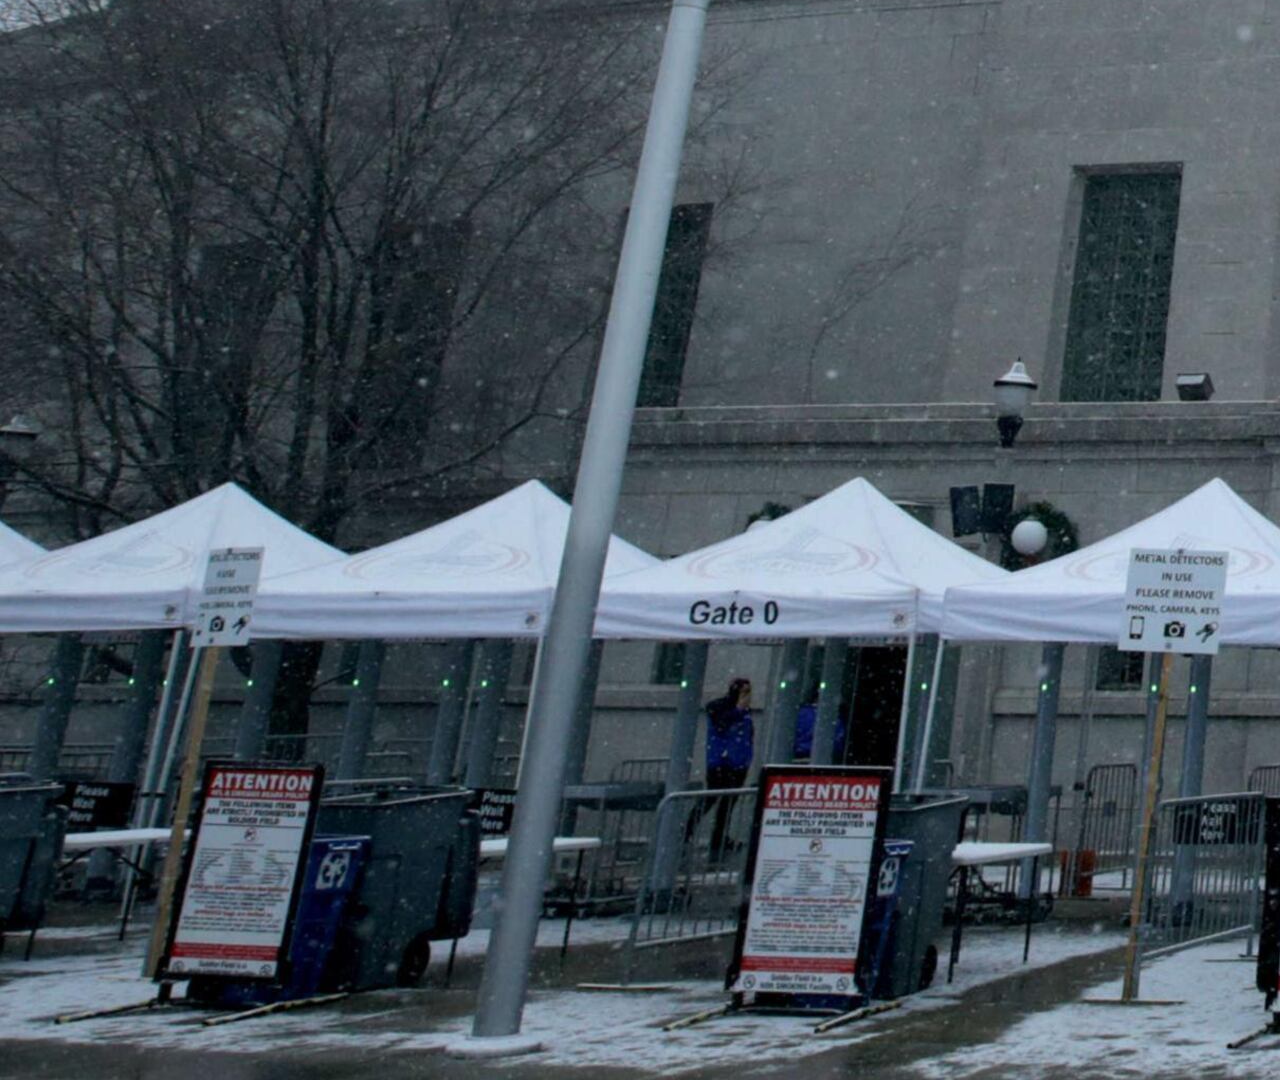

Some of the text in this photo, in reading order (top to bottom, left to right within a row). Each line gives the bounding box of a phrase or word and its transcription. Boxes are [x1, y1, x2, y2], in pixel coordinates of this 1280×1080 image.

[1135, 554, 1224, 566] METAL DETECTORS
[1162, 573, 1193, 582] IN USE
[1136, 588, 1214, 600] PLEASE REMOVE
[689, 600, 779, 625] Gate 0
[1200, 607, 1220, 616] KEYS
[211, 772, 314, 791] ATTENTION
[768, 782, 879, 800] ATTENTION
